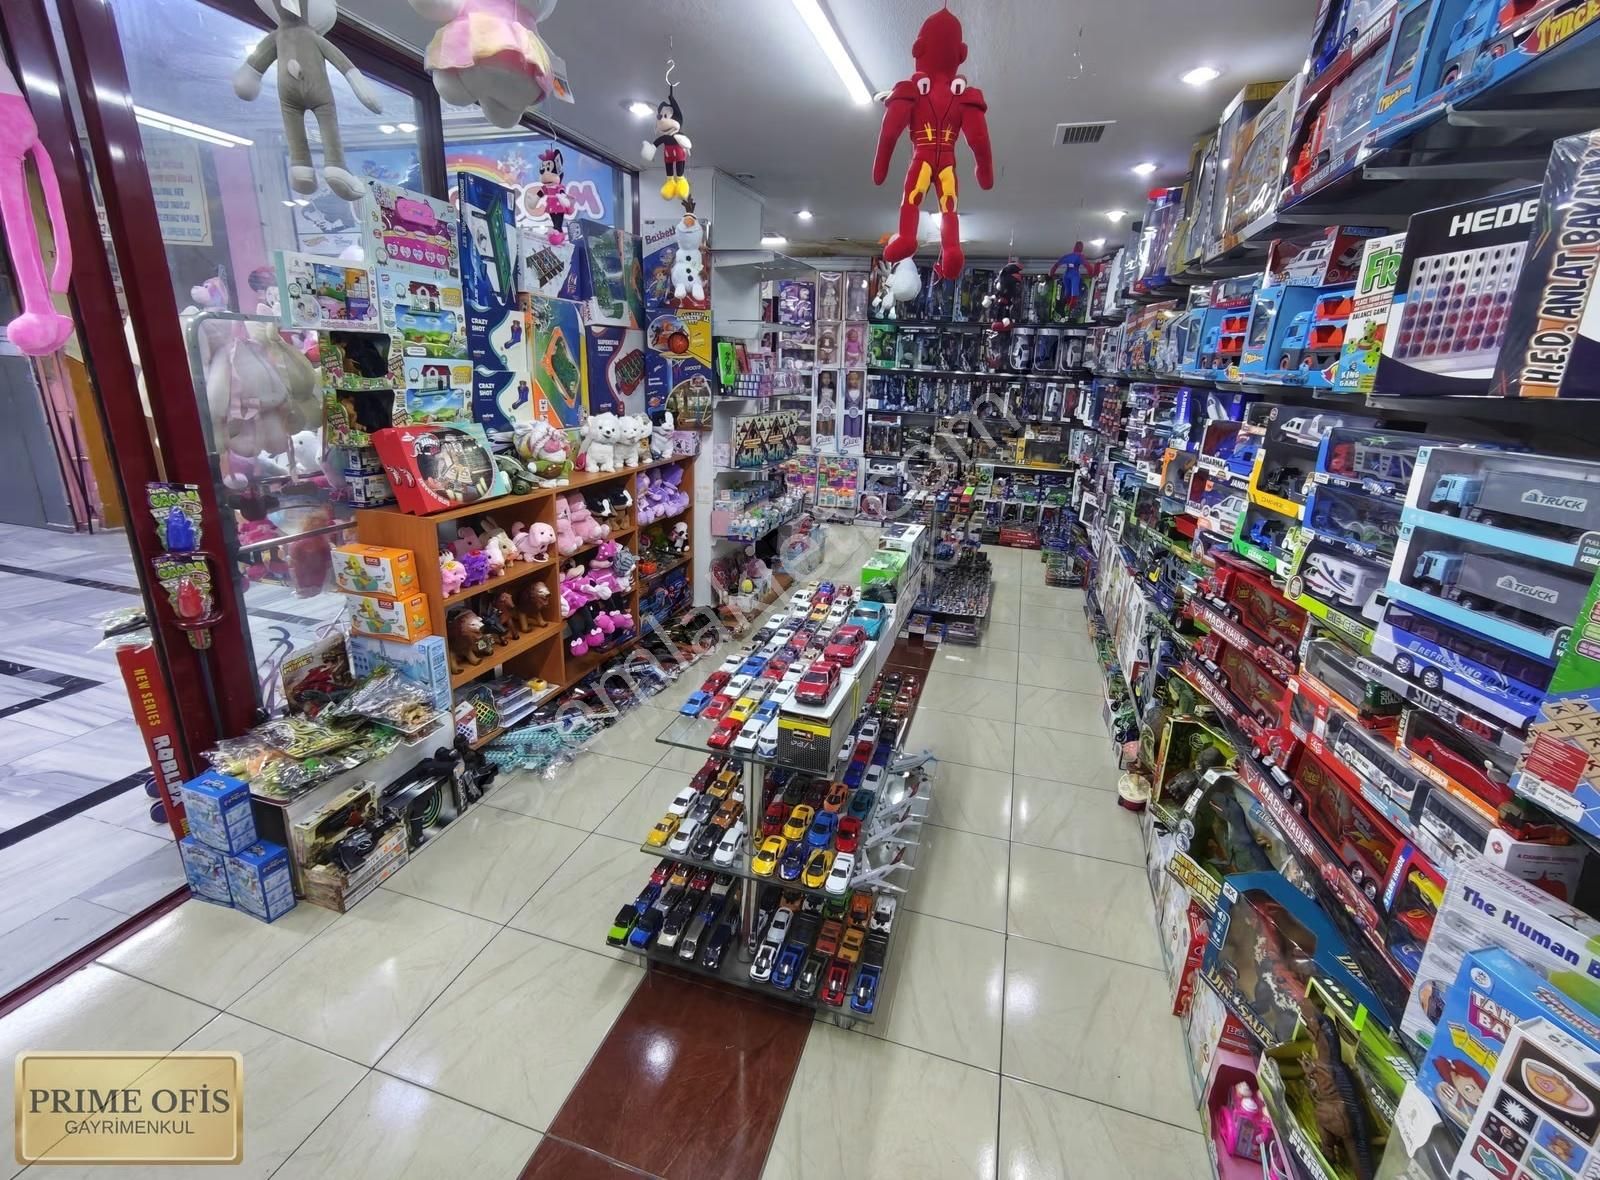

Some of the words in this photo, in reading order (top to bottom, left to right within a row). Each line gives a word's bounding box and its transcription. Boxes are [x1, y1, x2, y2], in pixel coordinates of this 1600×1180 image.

[1448, 198, 1540, 237] HEDE
[1360, 247, 1402, 295] FR
[1540, 252, 1600, 323] ANLAT
[471, 317, 489, 325] CRAZY
[597, 338, 620, 346] SUPERSTAR
[1520, 326, 1575, 387] H.E.D.
[1539, 495, 1583, 511] TRUCK
[1514, 581, 1555, 602] TRUCK
[1204, 610, 1226, 634] MACK
[1224, 625, 1249, 647] HAULER
[1327, 610, 1368, 641] DIE-CAST
[1357, 660, 1371, 674] CITY
[1371, 666, 1383, 678] BUS
[133, 668, 147, 691] NEW
[141, 692, 161, 727] SERIES
[1196, 671, 1215, 697] MACK
[1213, 691, 1234, 715] HAULER
[1413, 690, 1458, 722] SUPER
[152, 734, 183, 809] ROBLOX
[1259, 781, 1286, 817] MACK
[1284, 813, 1315, 857] HAULER
[1463, 885, 1498, 917] The
[1502, 909, 1581, 967] Human
[1471, 990, 1523, 1028] TAH
[1478, 1010, 1508, 1041] BA
